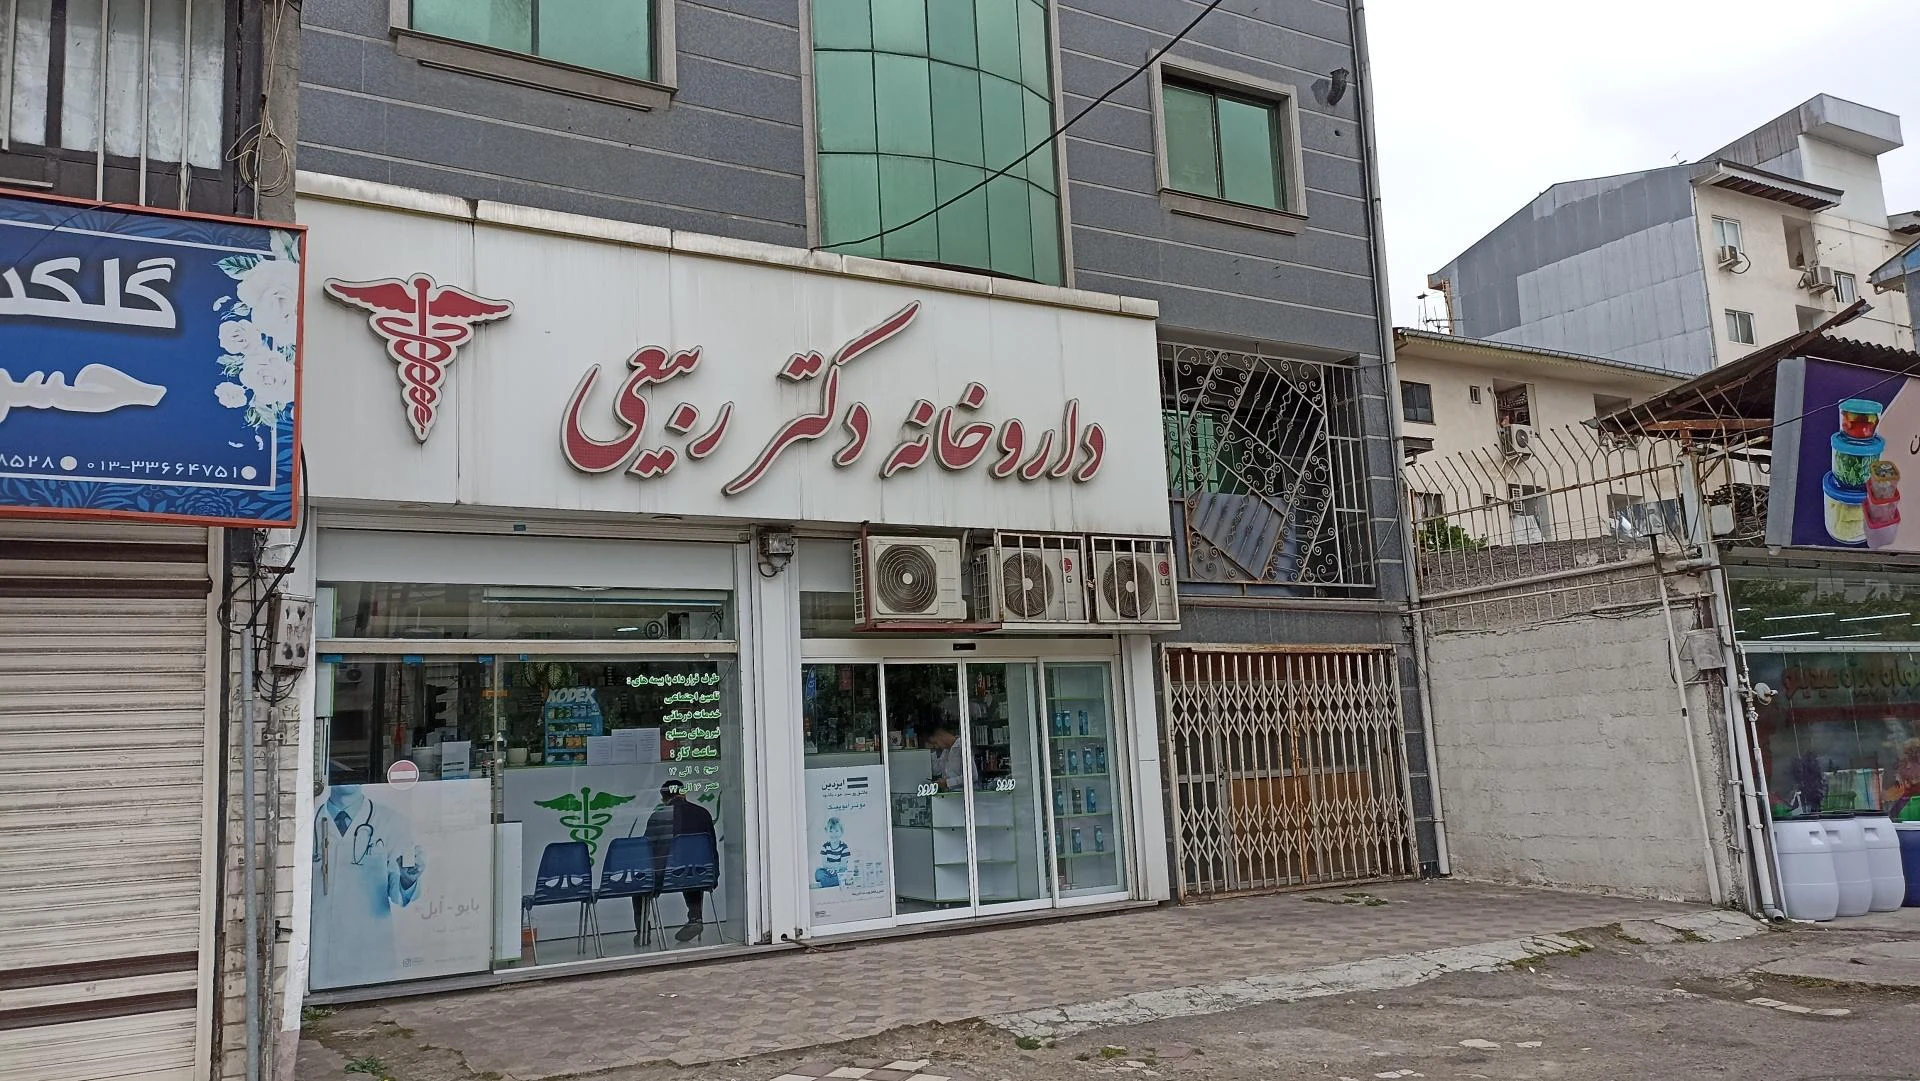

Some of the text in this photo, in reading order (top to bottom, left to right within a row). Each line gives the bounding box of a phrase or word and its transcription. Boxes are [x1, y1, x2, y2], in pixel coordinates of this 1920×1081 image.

[559, 300, 1106, 496] داروخانه دکتر ربیعی
[1160, 578, 1171, 586] LG
[649, 676, 664, 686] بیمه
[665, 674, 671, 686] با
[701, 673, 720, 685] طرف
[547, 687, 597, 703] KODEX
[664, 691, 698, 704] اجتماعی
[663, 709, 721, 722] خدمات درمانی
[666, 727, 720, 740] نیروهای مسلح
[692, 745, 717, 757] ساعت
[679, 765, 692, 777] الی
[703, 765, 719, 775] صبح
[679, 782, 693, 794] الی
[704, 782, 720, 792] عصر
[917, 782, 938, 797] ورود
[996, 778, 1016, 792] ورود
[454, 897, 480, 917] بایو
